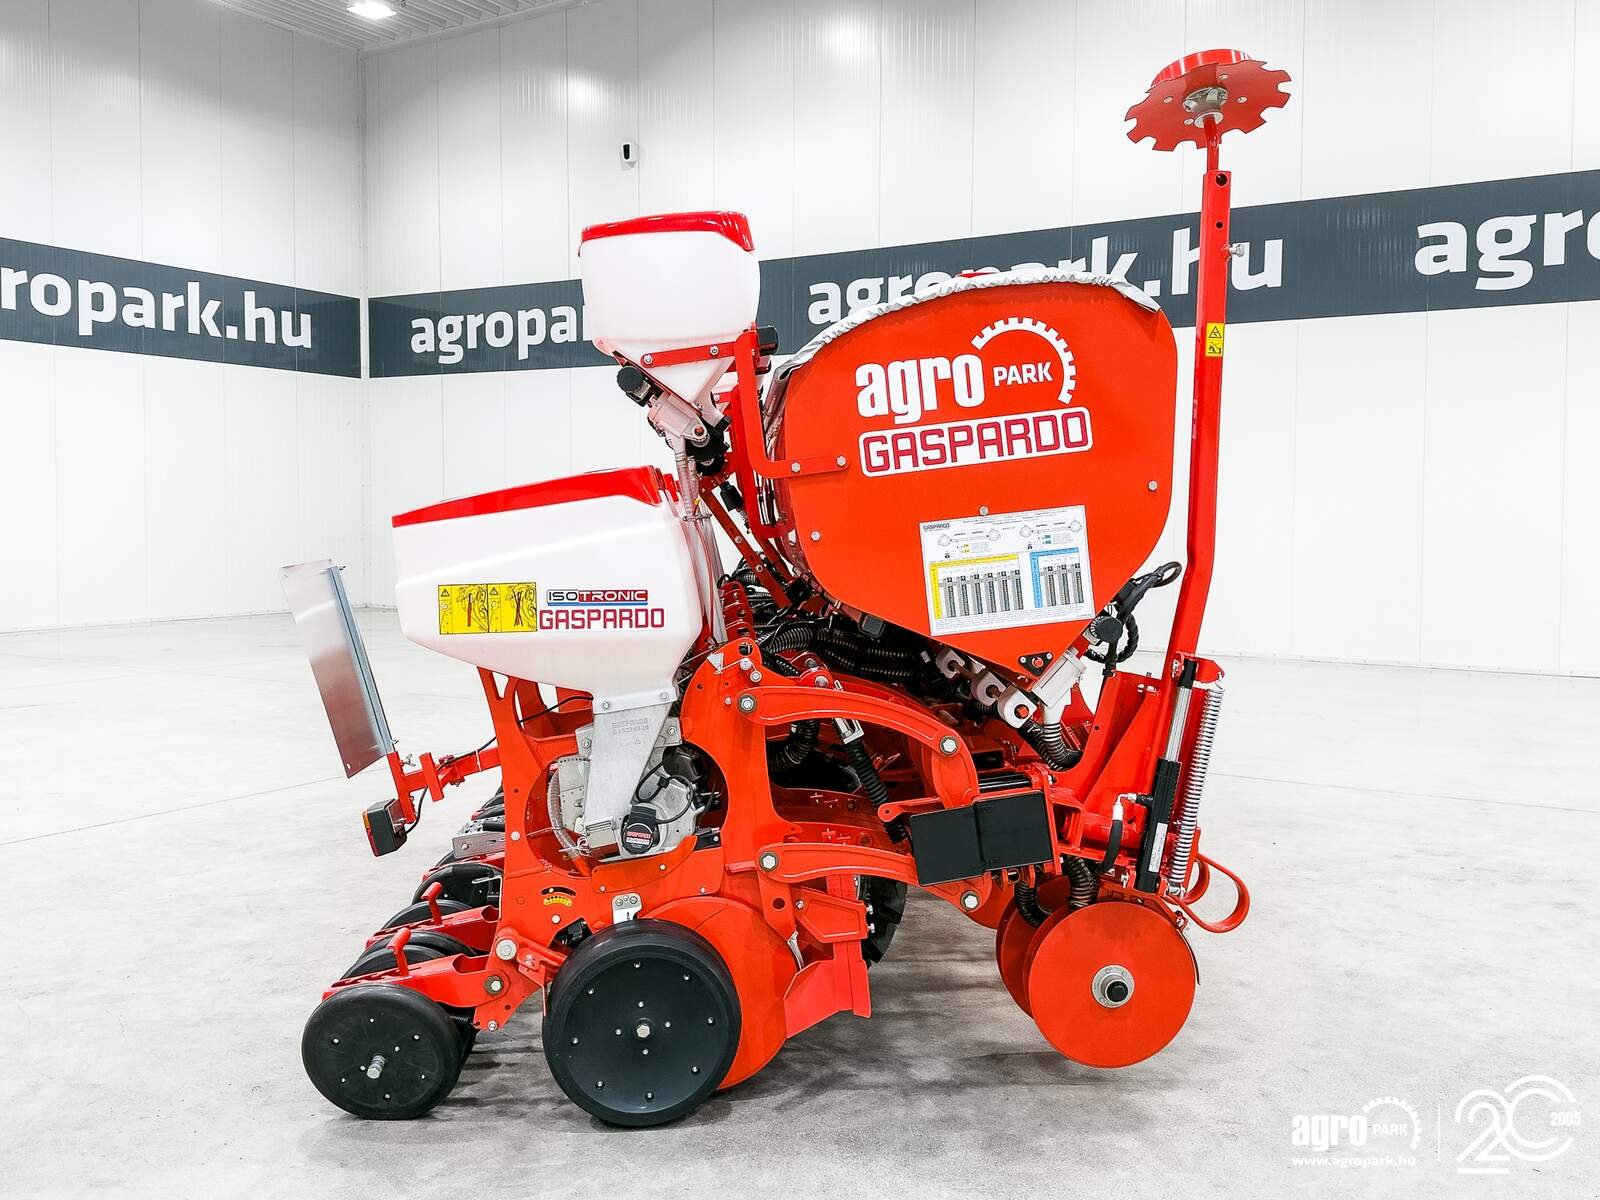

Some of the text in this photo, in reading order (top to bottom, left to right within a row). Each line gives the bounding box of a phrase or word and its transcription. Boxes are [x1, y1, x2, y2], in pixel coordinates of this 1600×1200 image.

[1414, 209, 1600, 291] agr
[855, 354, 1053, 425] agro PARK
[863, 411, 1089, 472] GASPARDO
[539, 608, 665, 630] GASPARDO
